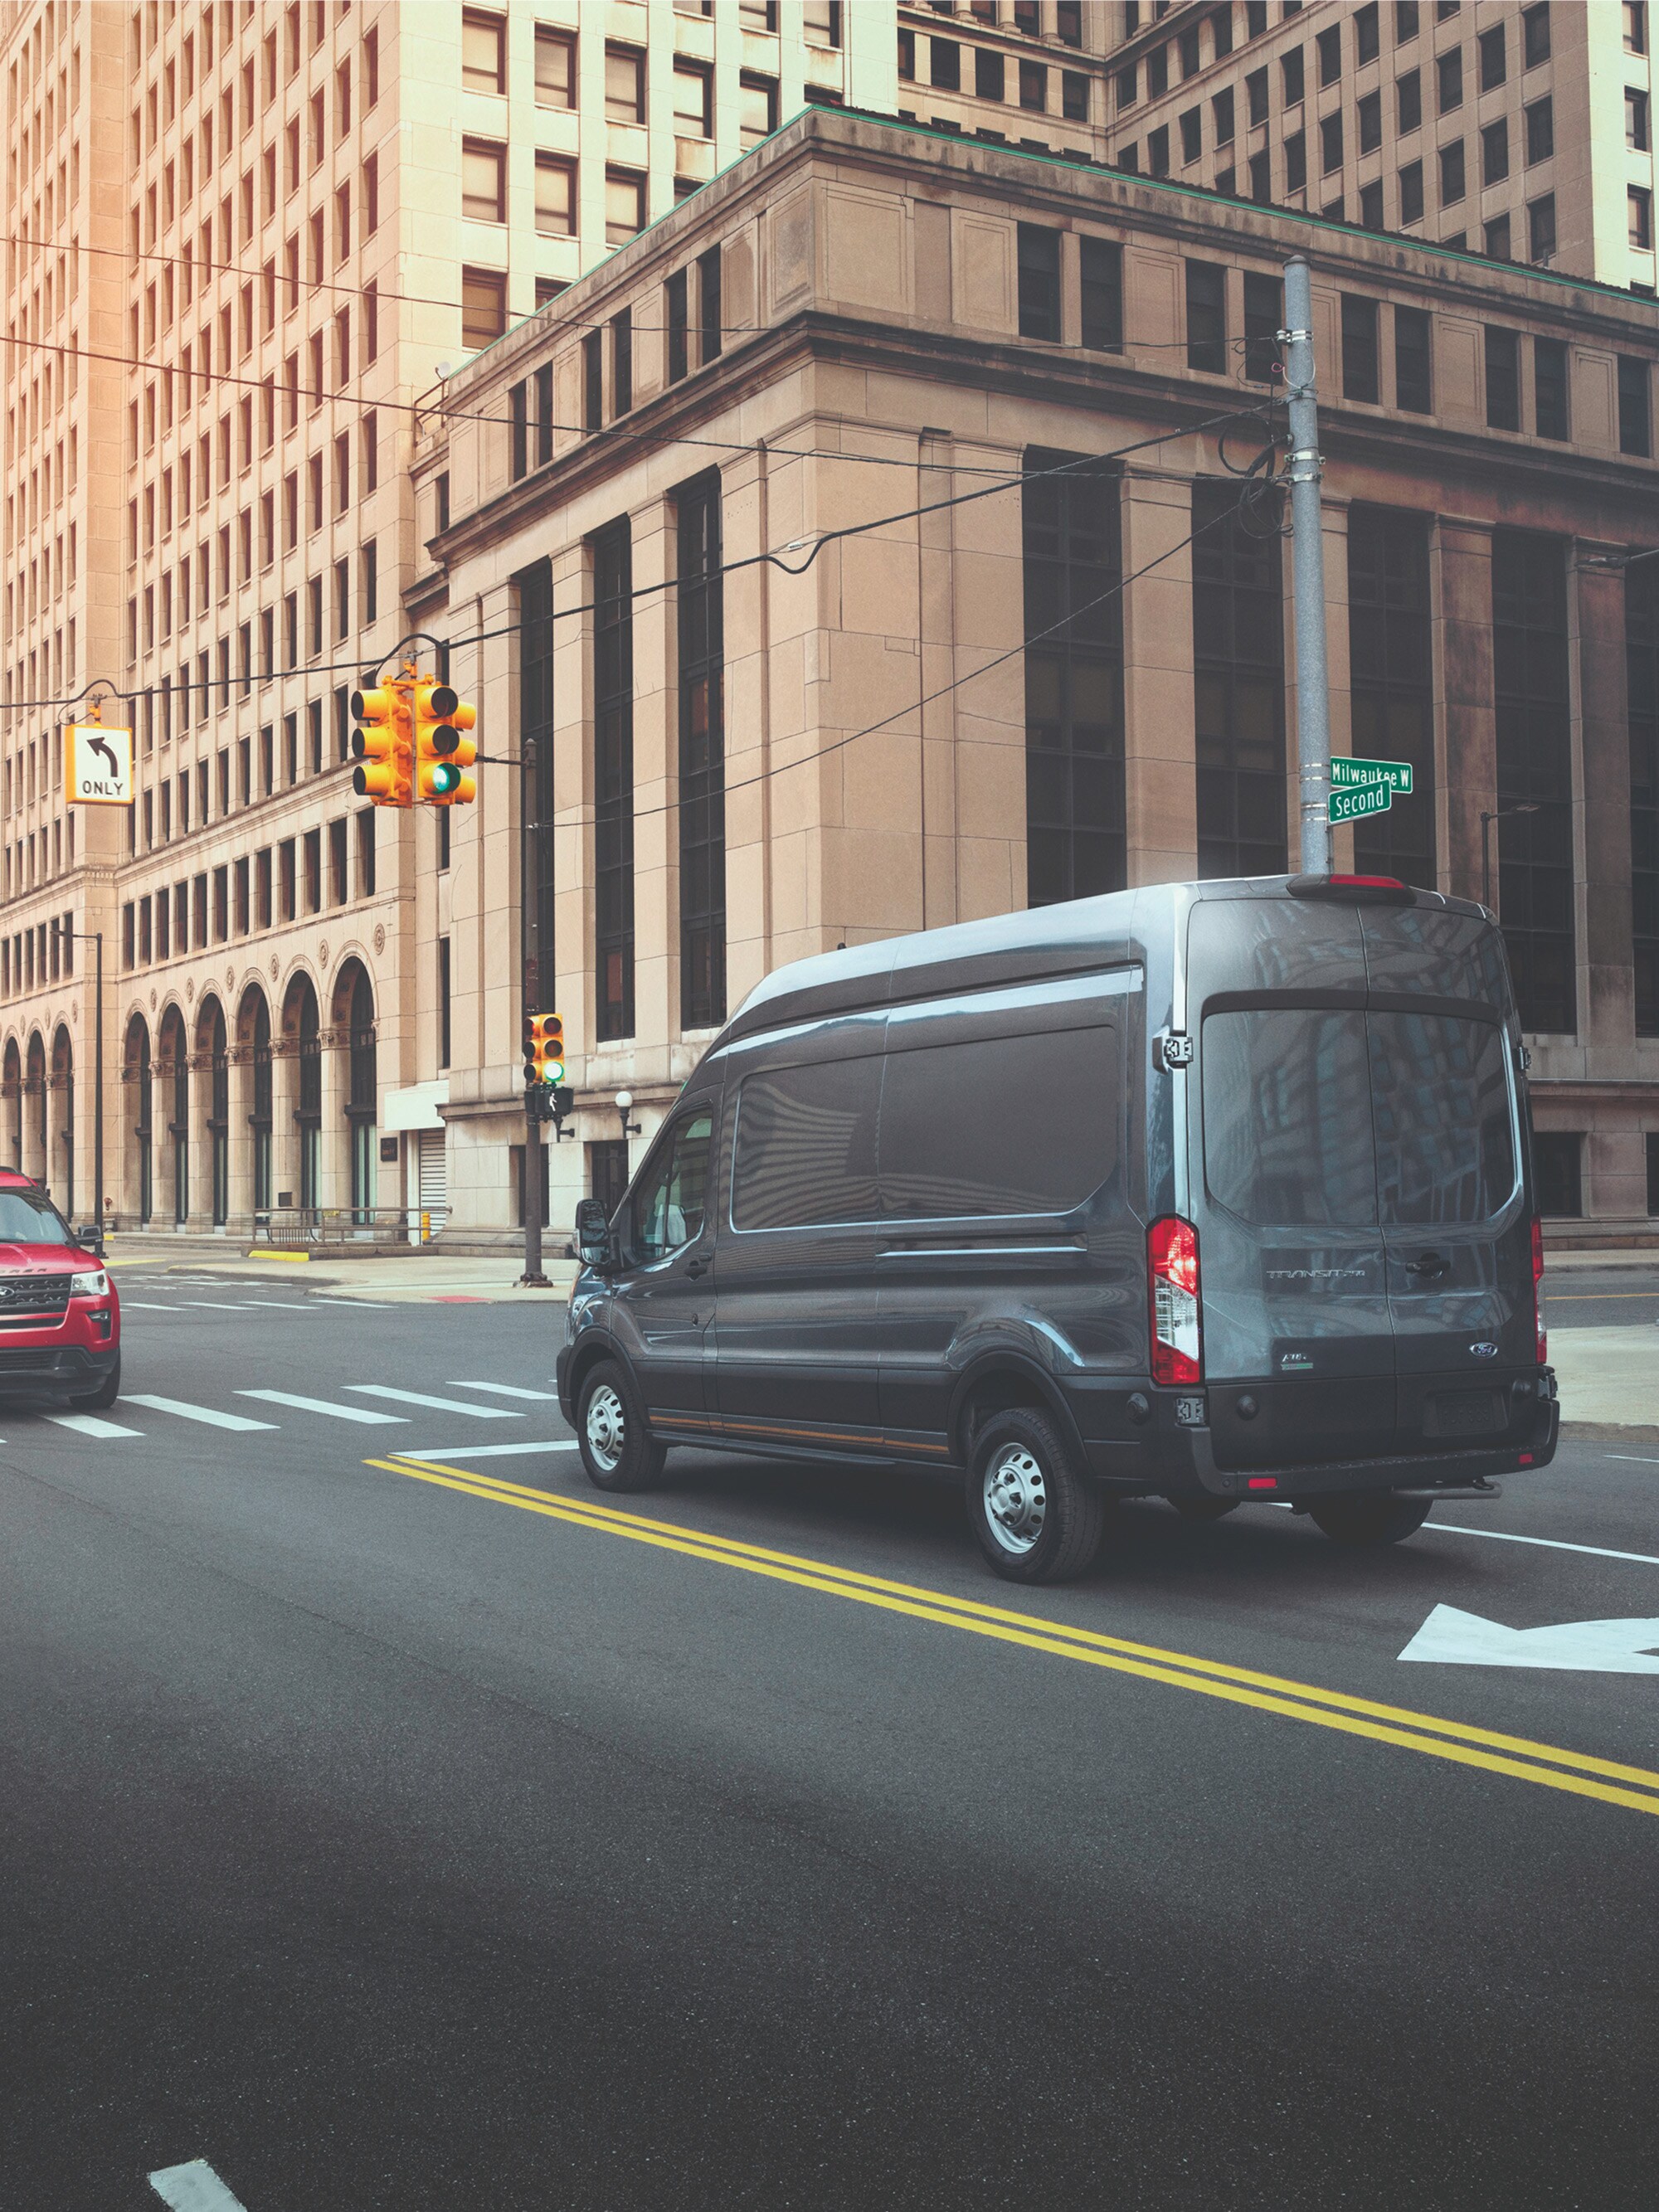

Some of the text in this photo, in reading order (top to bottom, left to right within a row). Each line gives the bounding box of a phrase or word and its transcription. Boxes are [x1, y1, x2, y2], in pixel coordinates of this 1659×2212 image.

[1332, 762, 1409, 787] Milwaukee W
[82, 780, 124, 796] ONLY
[1335, 784, 1384, 817] Second
[1266, 1269, 1343, 1279] TRANSIT
